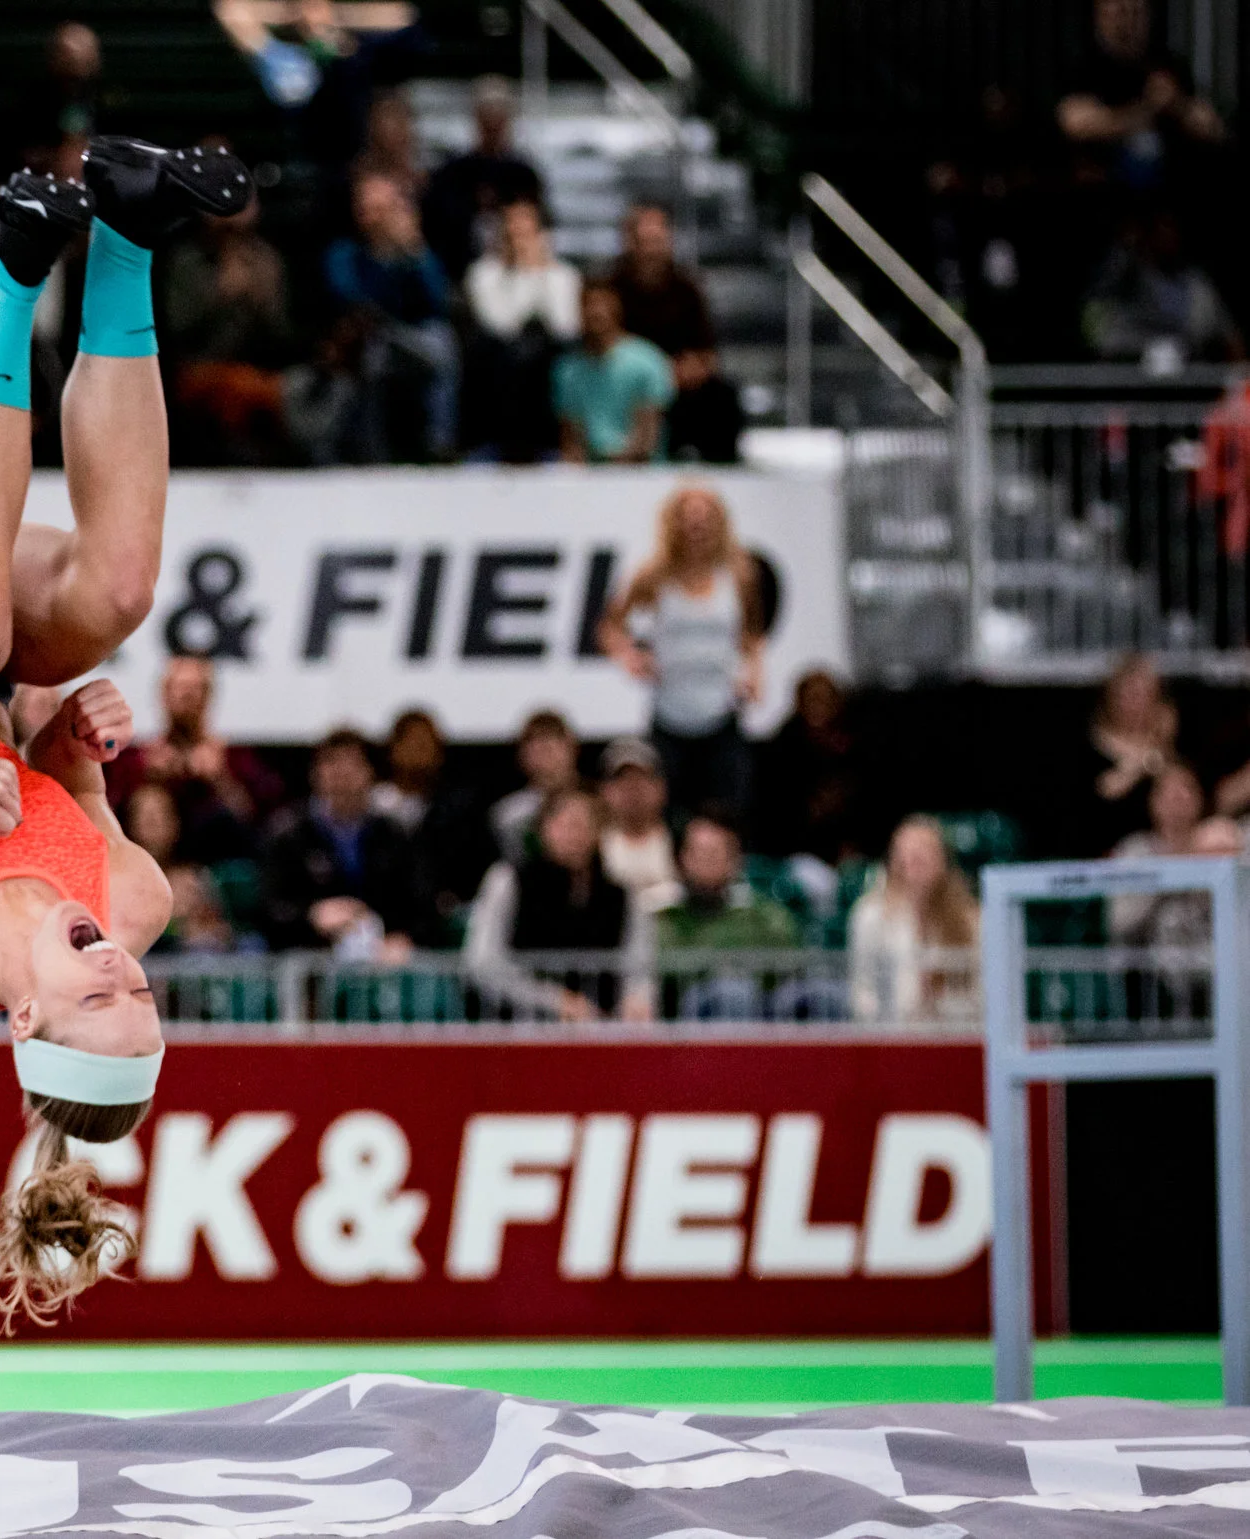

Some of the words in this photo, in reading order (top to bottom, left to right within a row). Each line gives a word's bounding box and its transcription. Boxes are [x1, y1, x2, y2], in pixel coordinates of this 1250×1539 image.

[162, 549, 255, 661] &
[299, 548, 784, 661] FIEL
[294, 1109, 427, 1285] &
[445, 1109, 993, 1280] FIELD
